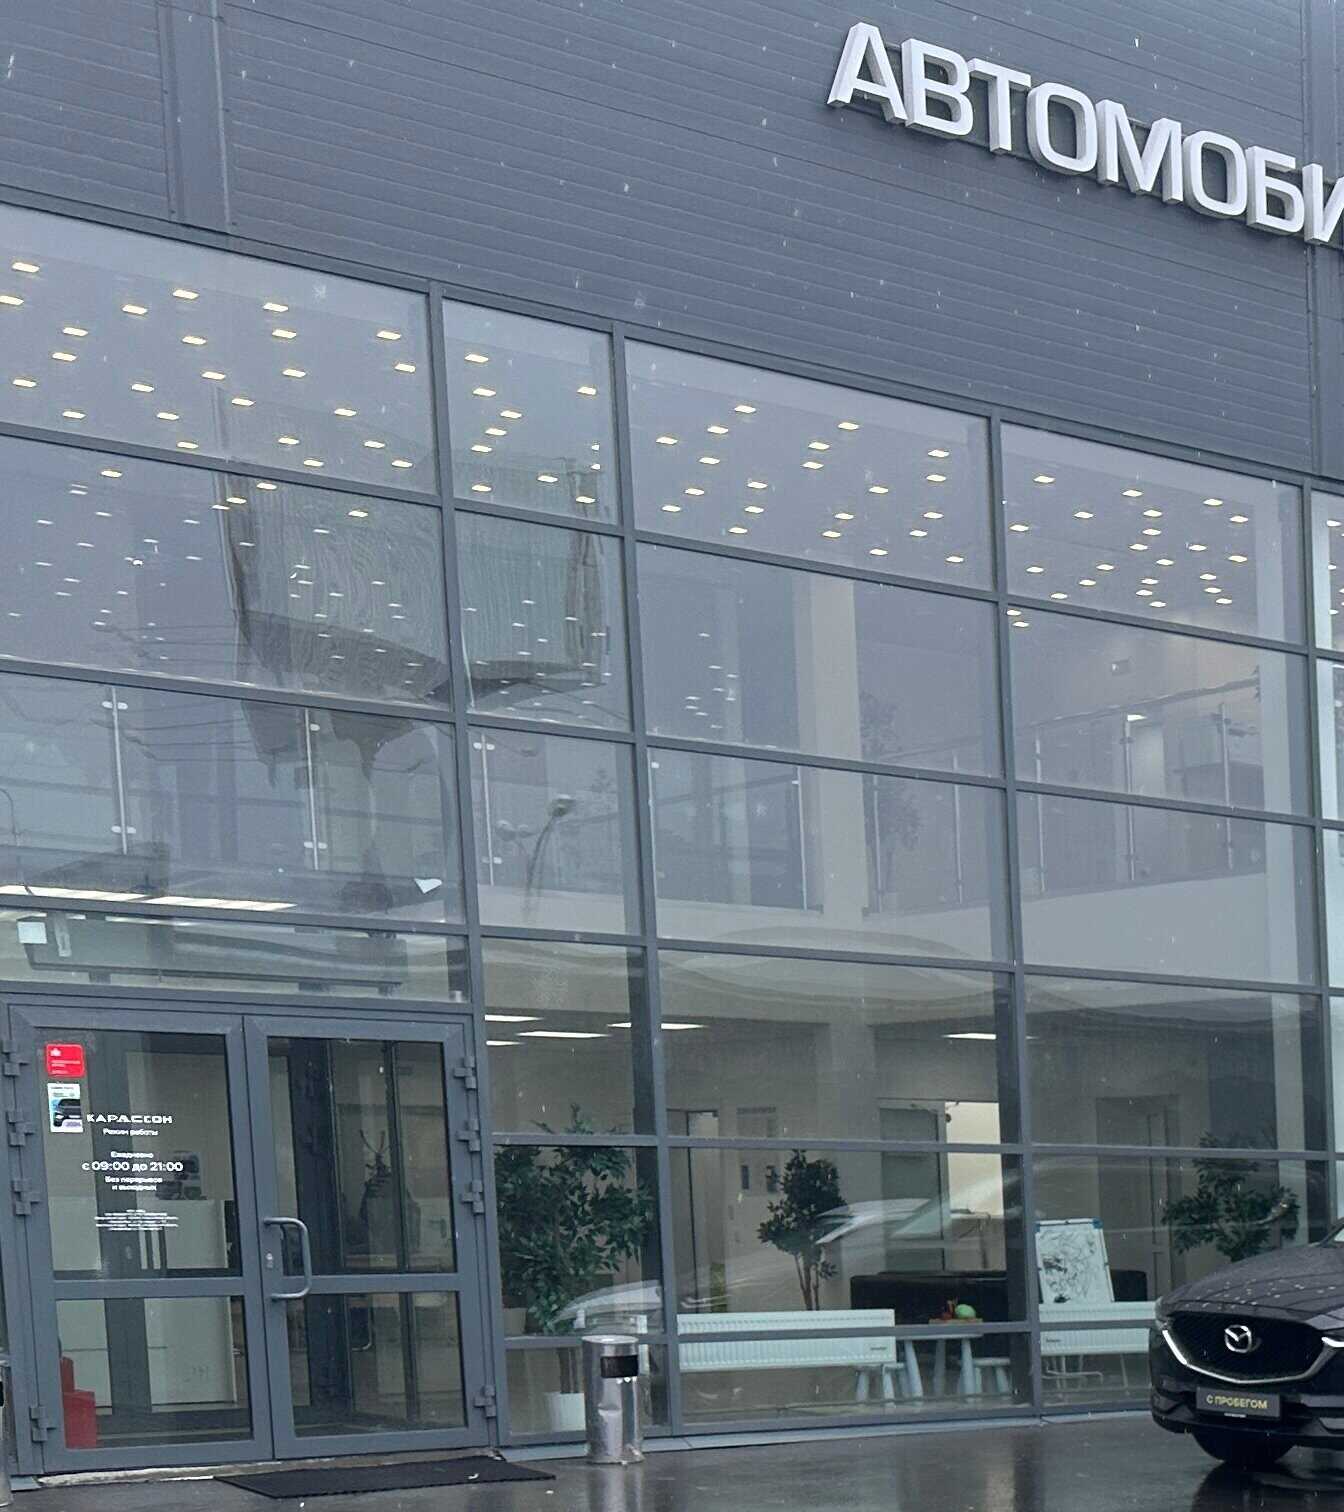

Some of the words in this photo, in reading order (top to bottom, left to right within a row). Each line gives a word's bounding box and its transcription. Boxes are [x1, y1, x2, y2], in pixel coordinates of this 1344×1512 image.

[91, 1161, 130, 1171] 09:00
[132, 1163, 148, 1172] до
[150, 1162, 184, 1171] 21:00
